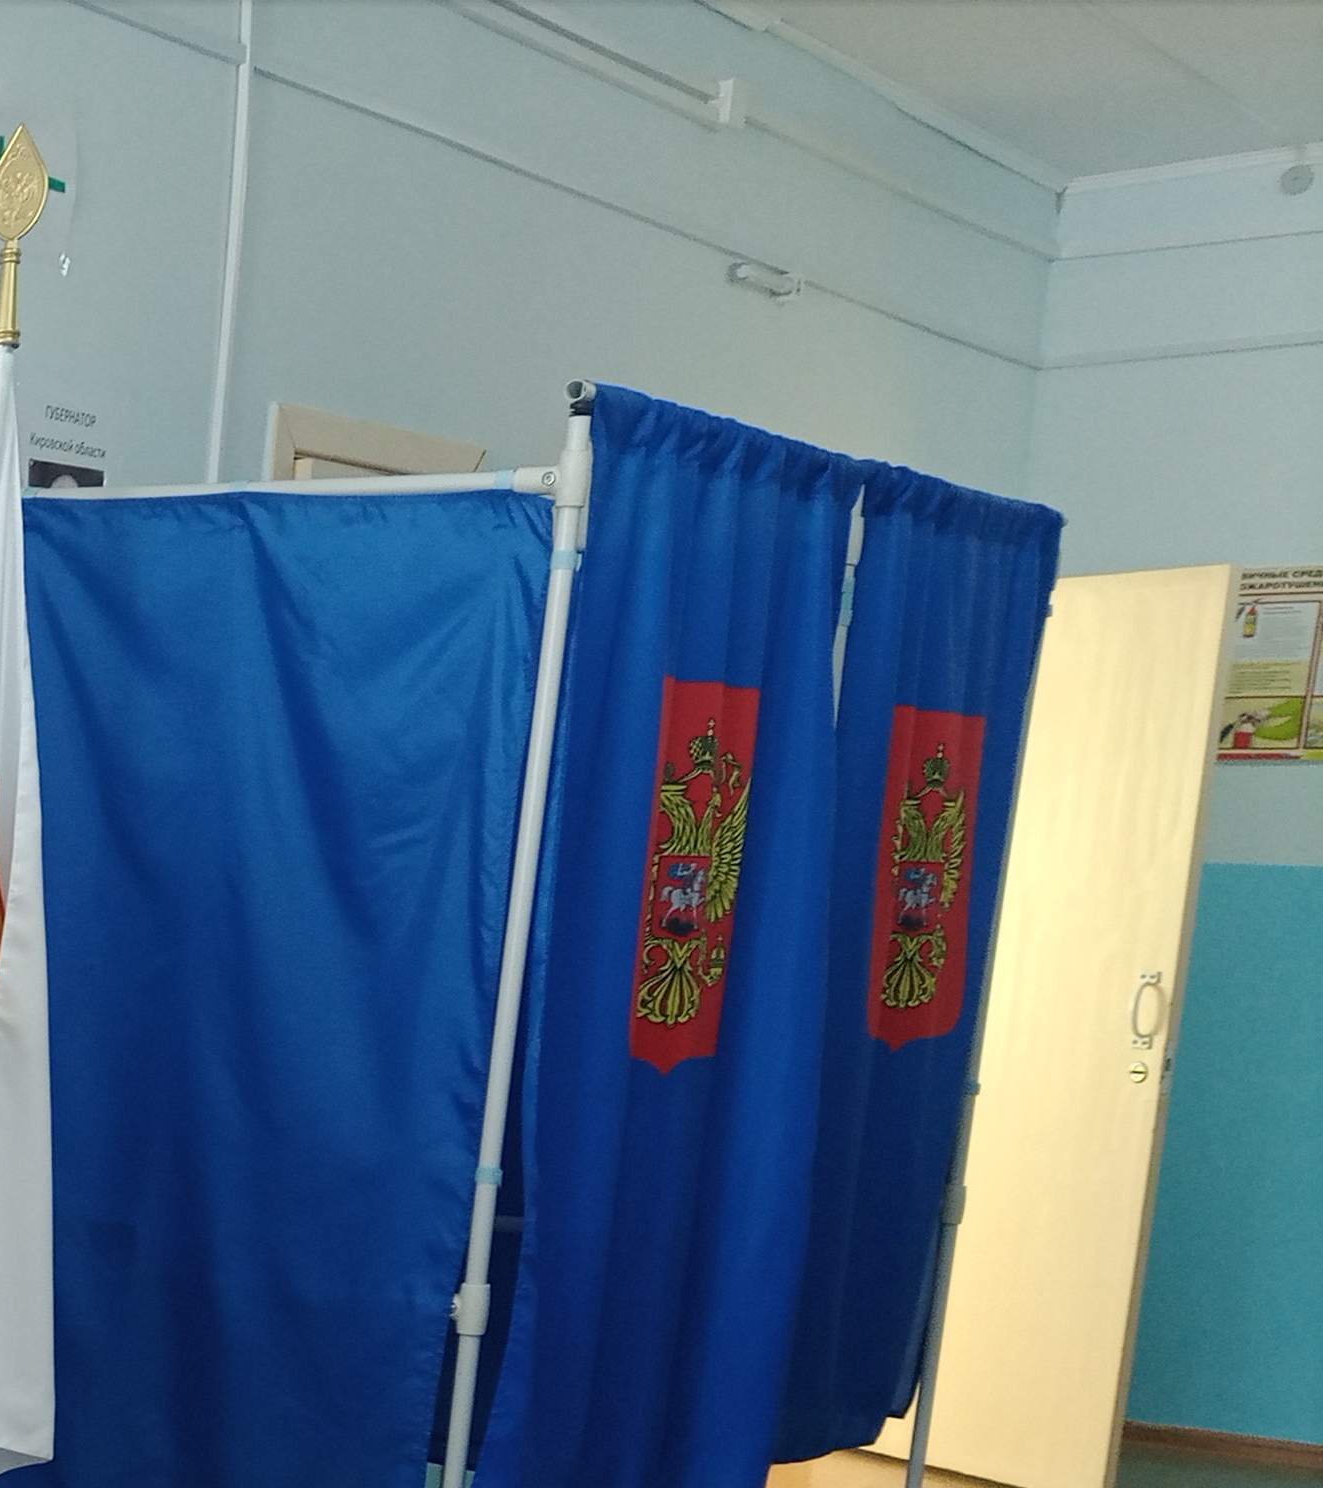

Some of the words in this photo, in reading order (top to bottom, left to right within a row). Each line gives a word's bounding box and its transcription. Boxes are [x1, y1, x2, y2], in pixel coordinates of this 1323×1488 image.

[45, 405, 96, 428] ГУБЕРНАТОР
[30, 432, 74, 452] Кировской
[75, 441, 106, 459] области
